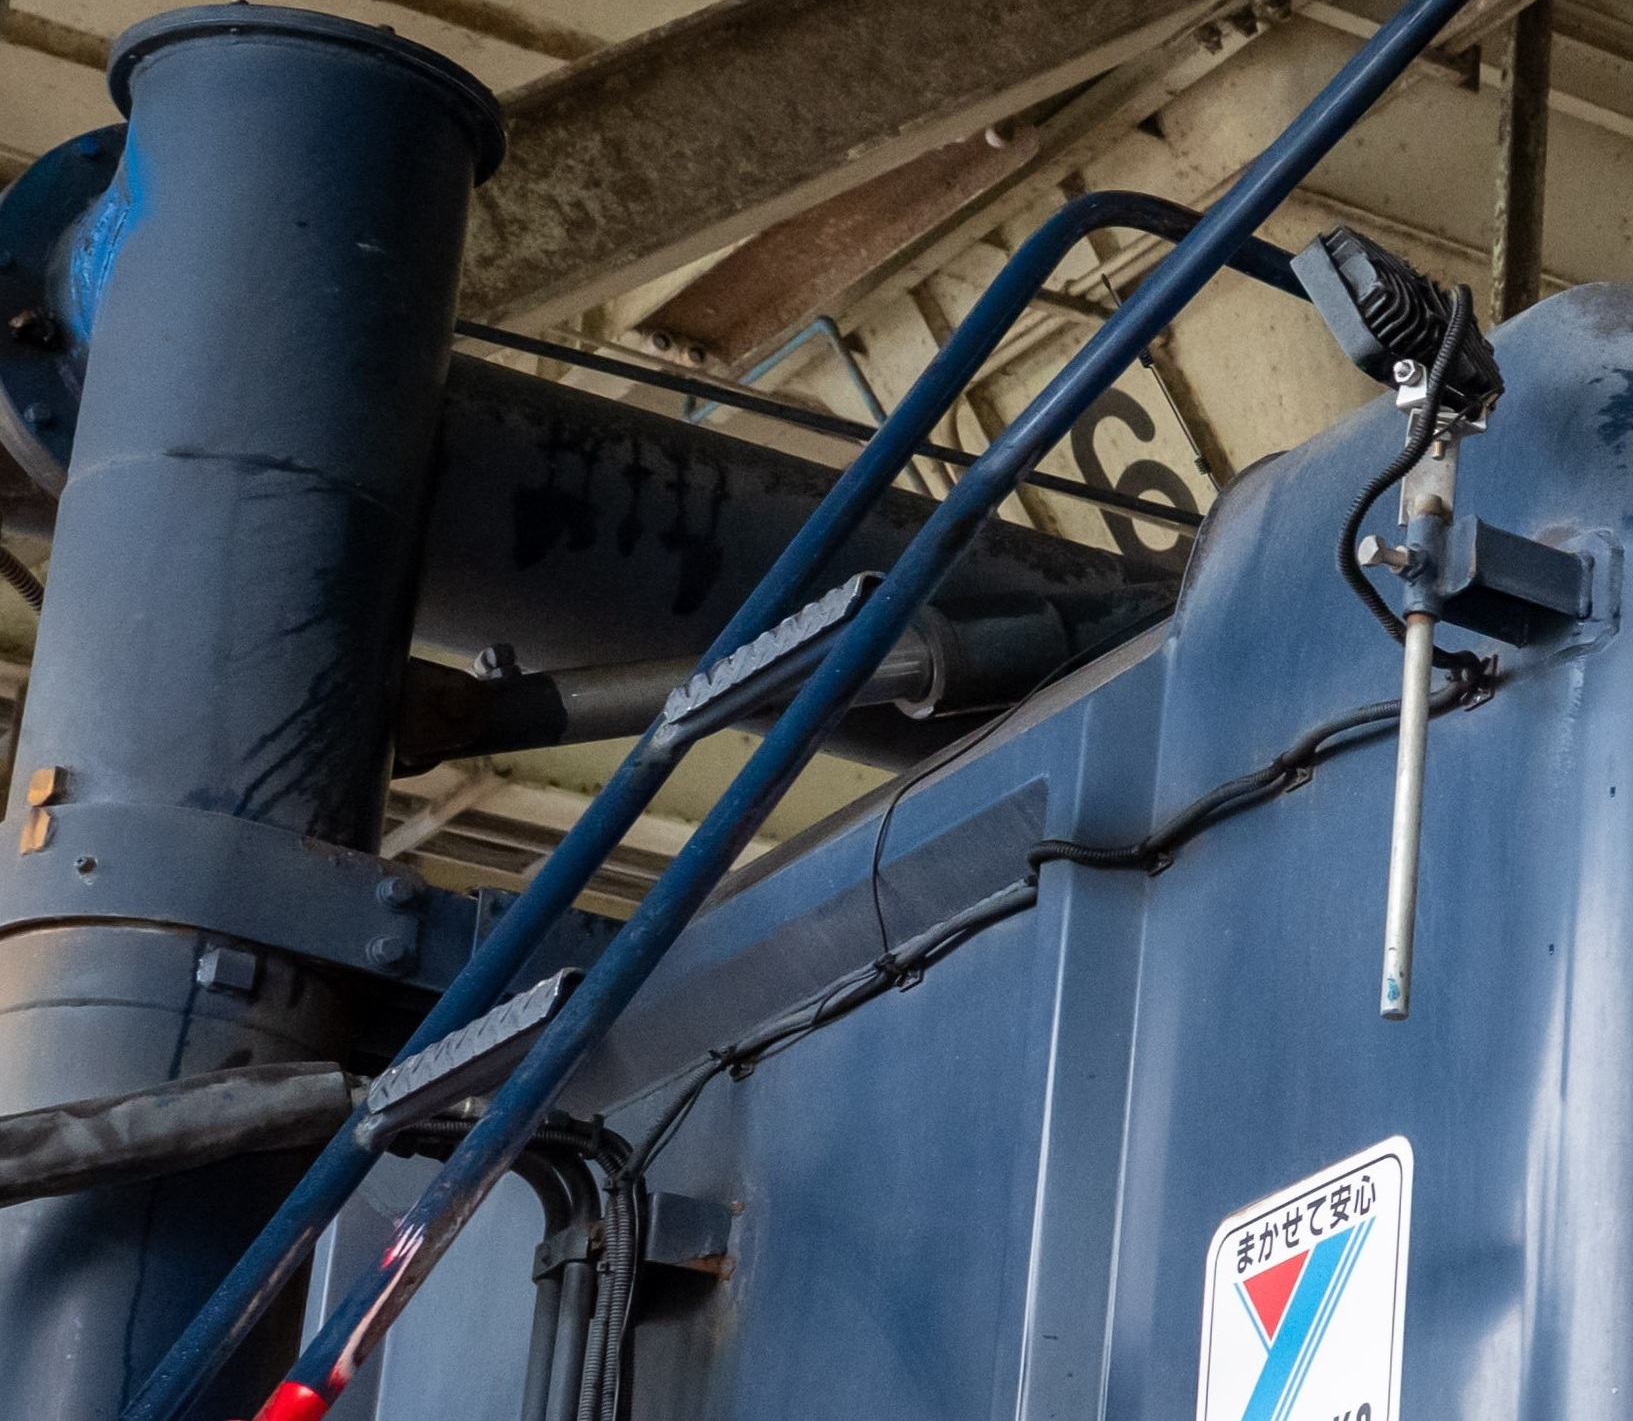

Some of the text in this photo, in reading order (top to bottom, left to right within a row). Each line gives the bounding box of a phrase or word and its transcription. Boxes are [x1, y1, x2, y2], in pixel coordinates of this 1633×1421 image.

[1070, 386, 1200, 574] 6
[1236, 1174, 1377, 1274] まかせて安心
